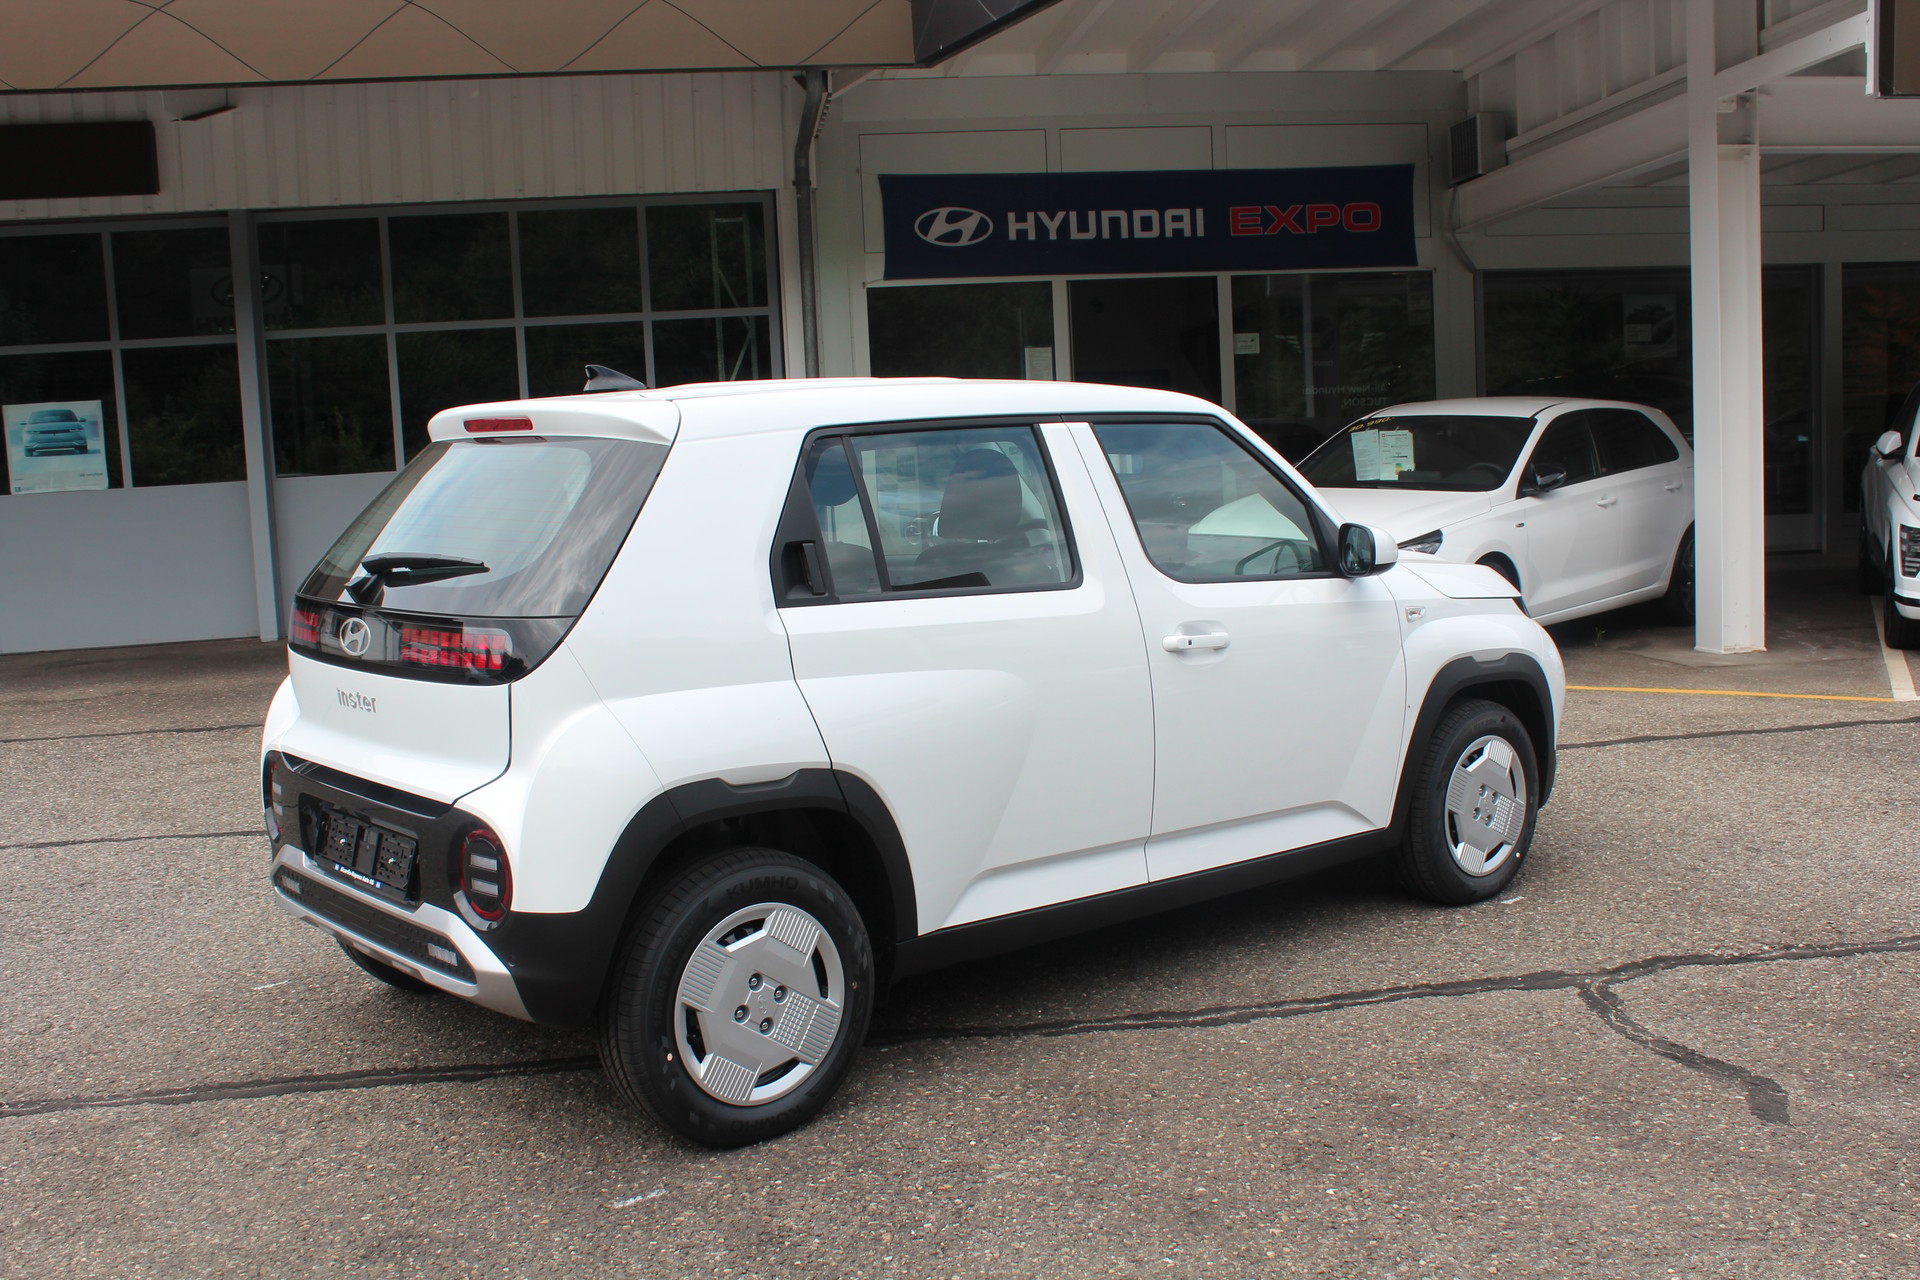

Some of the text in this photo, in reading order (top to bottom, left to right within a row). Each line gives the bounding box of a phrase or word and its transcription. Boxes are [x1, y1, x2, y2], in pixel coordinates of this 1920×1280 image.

[1007, 202, 1382, 241] HYUNDAI EXPO
[336, 687, 377, 714] inster
[725, 875, 799, 898] KUMHO
